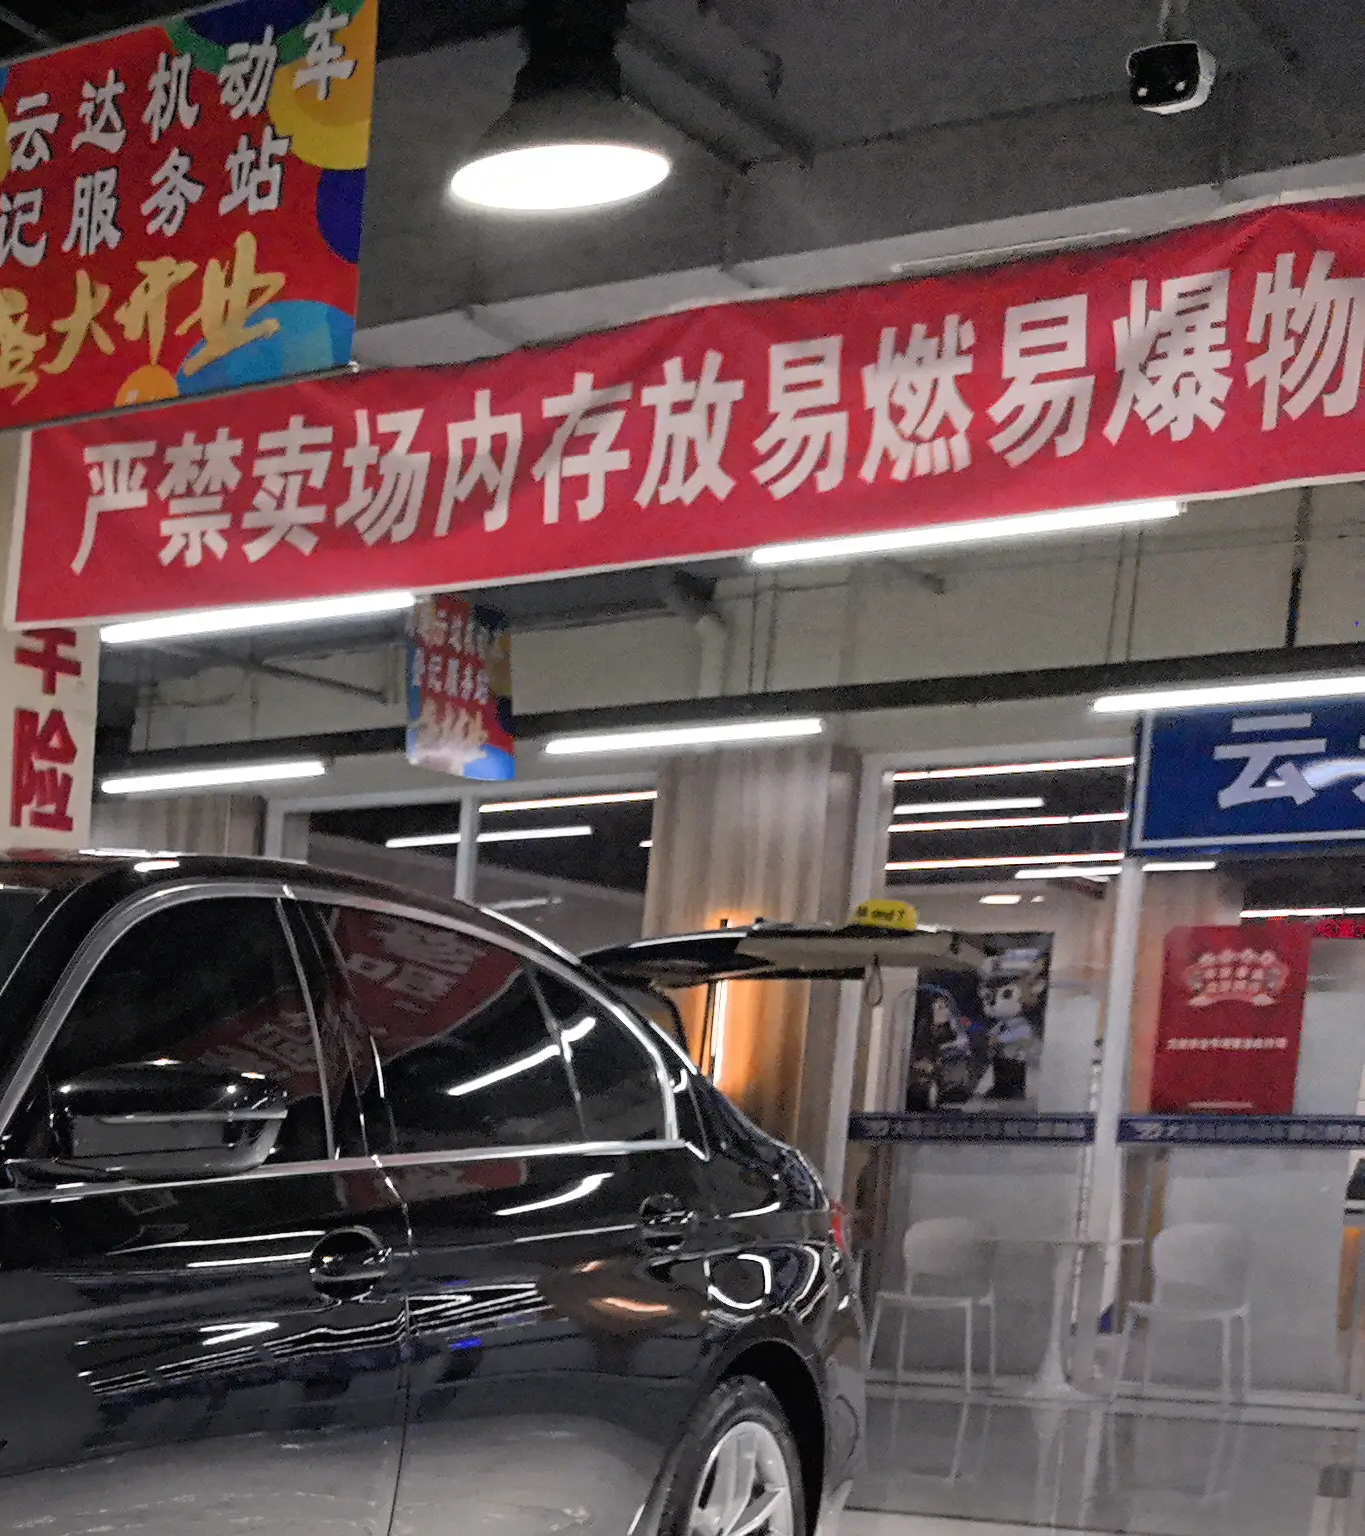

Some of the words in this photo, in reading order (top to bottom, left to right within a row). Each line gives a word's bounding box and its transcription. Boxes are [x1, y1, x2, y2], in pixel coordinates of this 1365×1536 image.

[71, 250, 1365, 576] 严禁卖场内存放易燃易爆物
[1213, 712, 1365, 809] 云
